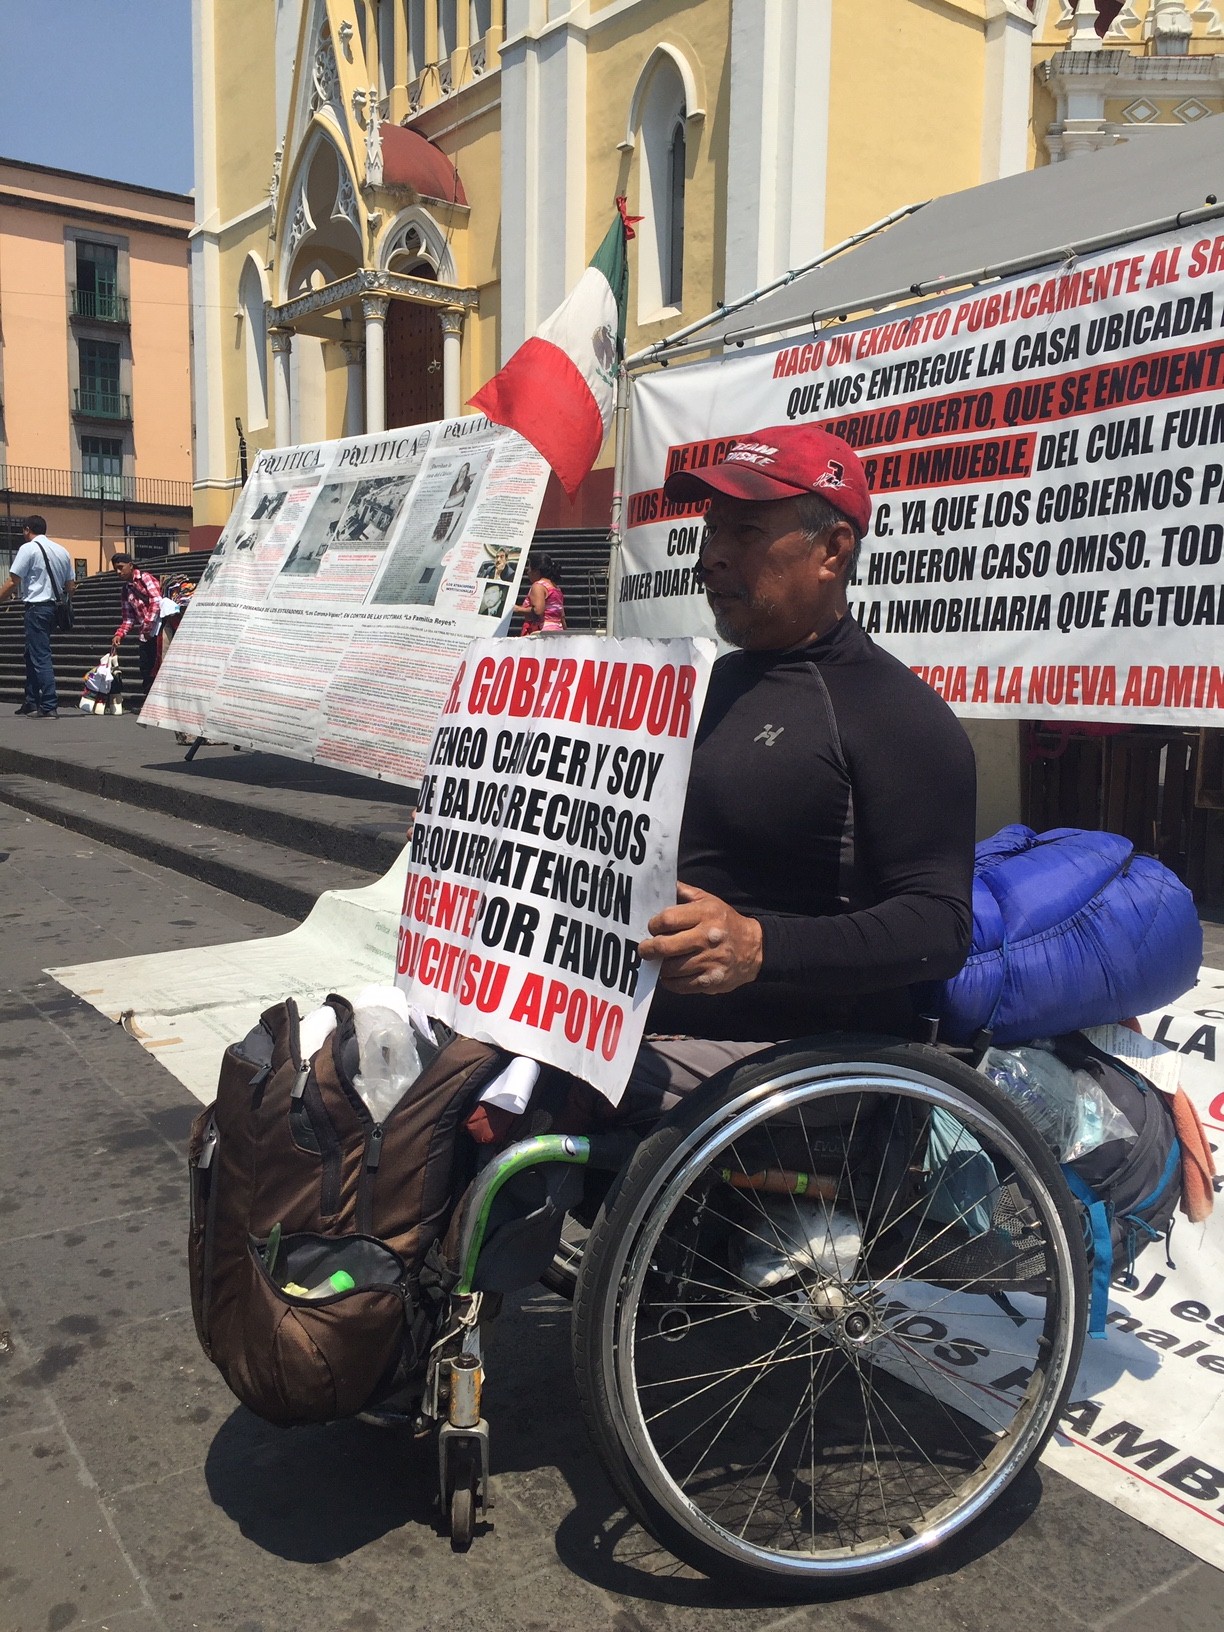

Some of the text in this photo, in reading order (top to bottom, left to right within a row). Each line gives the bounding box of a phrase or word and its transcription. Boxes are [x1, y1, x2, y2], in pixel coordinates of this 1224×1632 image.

[772, 340, 823, 378] HAGO
[826, 333, 856, 367] UN
[856, 308, 951, 360] EXHORTO
[951, 255, 1145, 335] PUBLICAMENTE
[1145, 246, 1182, 289] AL
[786, 382, 824, 419] QUE
[823, 373, 865, 410] NOS
[866, 346, 975, 402] ENTREGUE
[976, 340, 1006, 378] LA
[1011, 323, 1081, 372] CASA
[1085, 291, 1213, 356] UBICADA
[691, 444, 710, 469] LA
[902, 392, 996, 438] PUERTO,
[1002, 382, 1055, 426] QUE
[1059, 373, 1091, 416] SE
[1093, 346, 1224, 408] ENCUENT
[637, 496, 657, 521] LOS
[880, 455, 901, 489] EL
[906, 438, 1030, 486] INMUEBLE,
[1036, 429, 1079, 471] DEL
[1086, 415, 1154, 463] CUAL
[667, 526, 699, 557] CON
[874, 503, 893, 537] C.
[901, 500, 926, 534] YA
[931, 495, 979, 536] QUE
[982, 489, 1031, 528] LOS
[1036, 466, 1194, 524] GOBIERNOS
[1199, 463, 1224, 505] P
[619, 572, 652, 603] JAVIER
[868, 546, 977, 586] HICIERON
[981, 540, 1051, 580] CASO
[1056, 529, 1150, 576] OMISO.
[1161, 524, 1223, 567] TOD
[857, 601, 881, 633] LA
[885, 594, 1051, 633] INMOBILIARIA
[1057, 590, 1109, 633] QUE
[442, 660, 466, 716] R.
[468, 656, 697, 739] GOBERNADOR
[971, 666, 988, 702] A
[993, 666, 1023, 703] LA
[1027, 665, 1116, 706] NUEVA
[430, 726, 488, 770] TENGO
[590, 743, 611, 790] Y
[606, 746, 664, 802] SOY
[416, 774, 650, 866] DE BAJOS RECURSOS
[411, 823, 633, 925] REQUIERO ATENCIÓN
[470, 892, 540, 958] POR
[543, 913, 642, 998] FAVOR
[459, 953, 510, 1014] SU
[509, 972, 624, 1062] APOYO
[1153, 1014, 1216, 1062] LA
